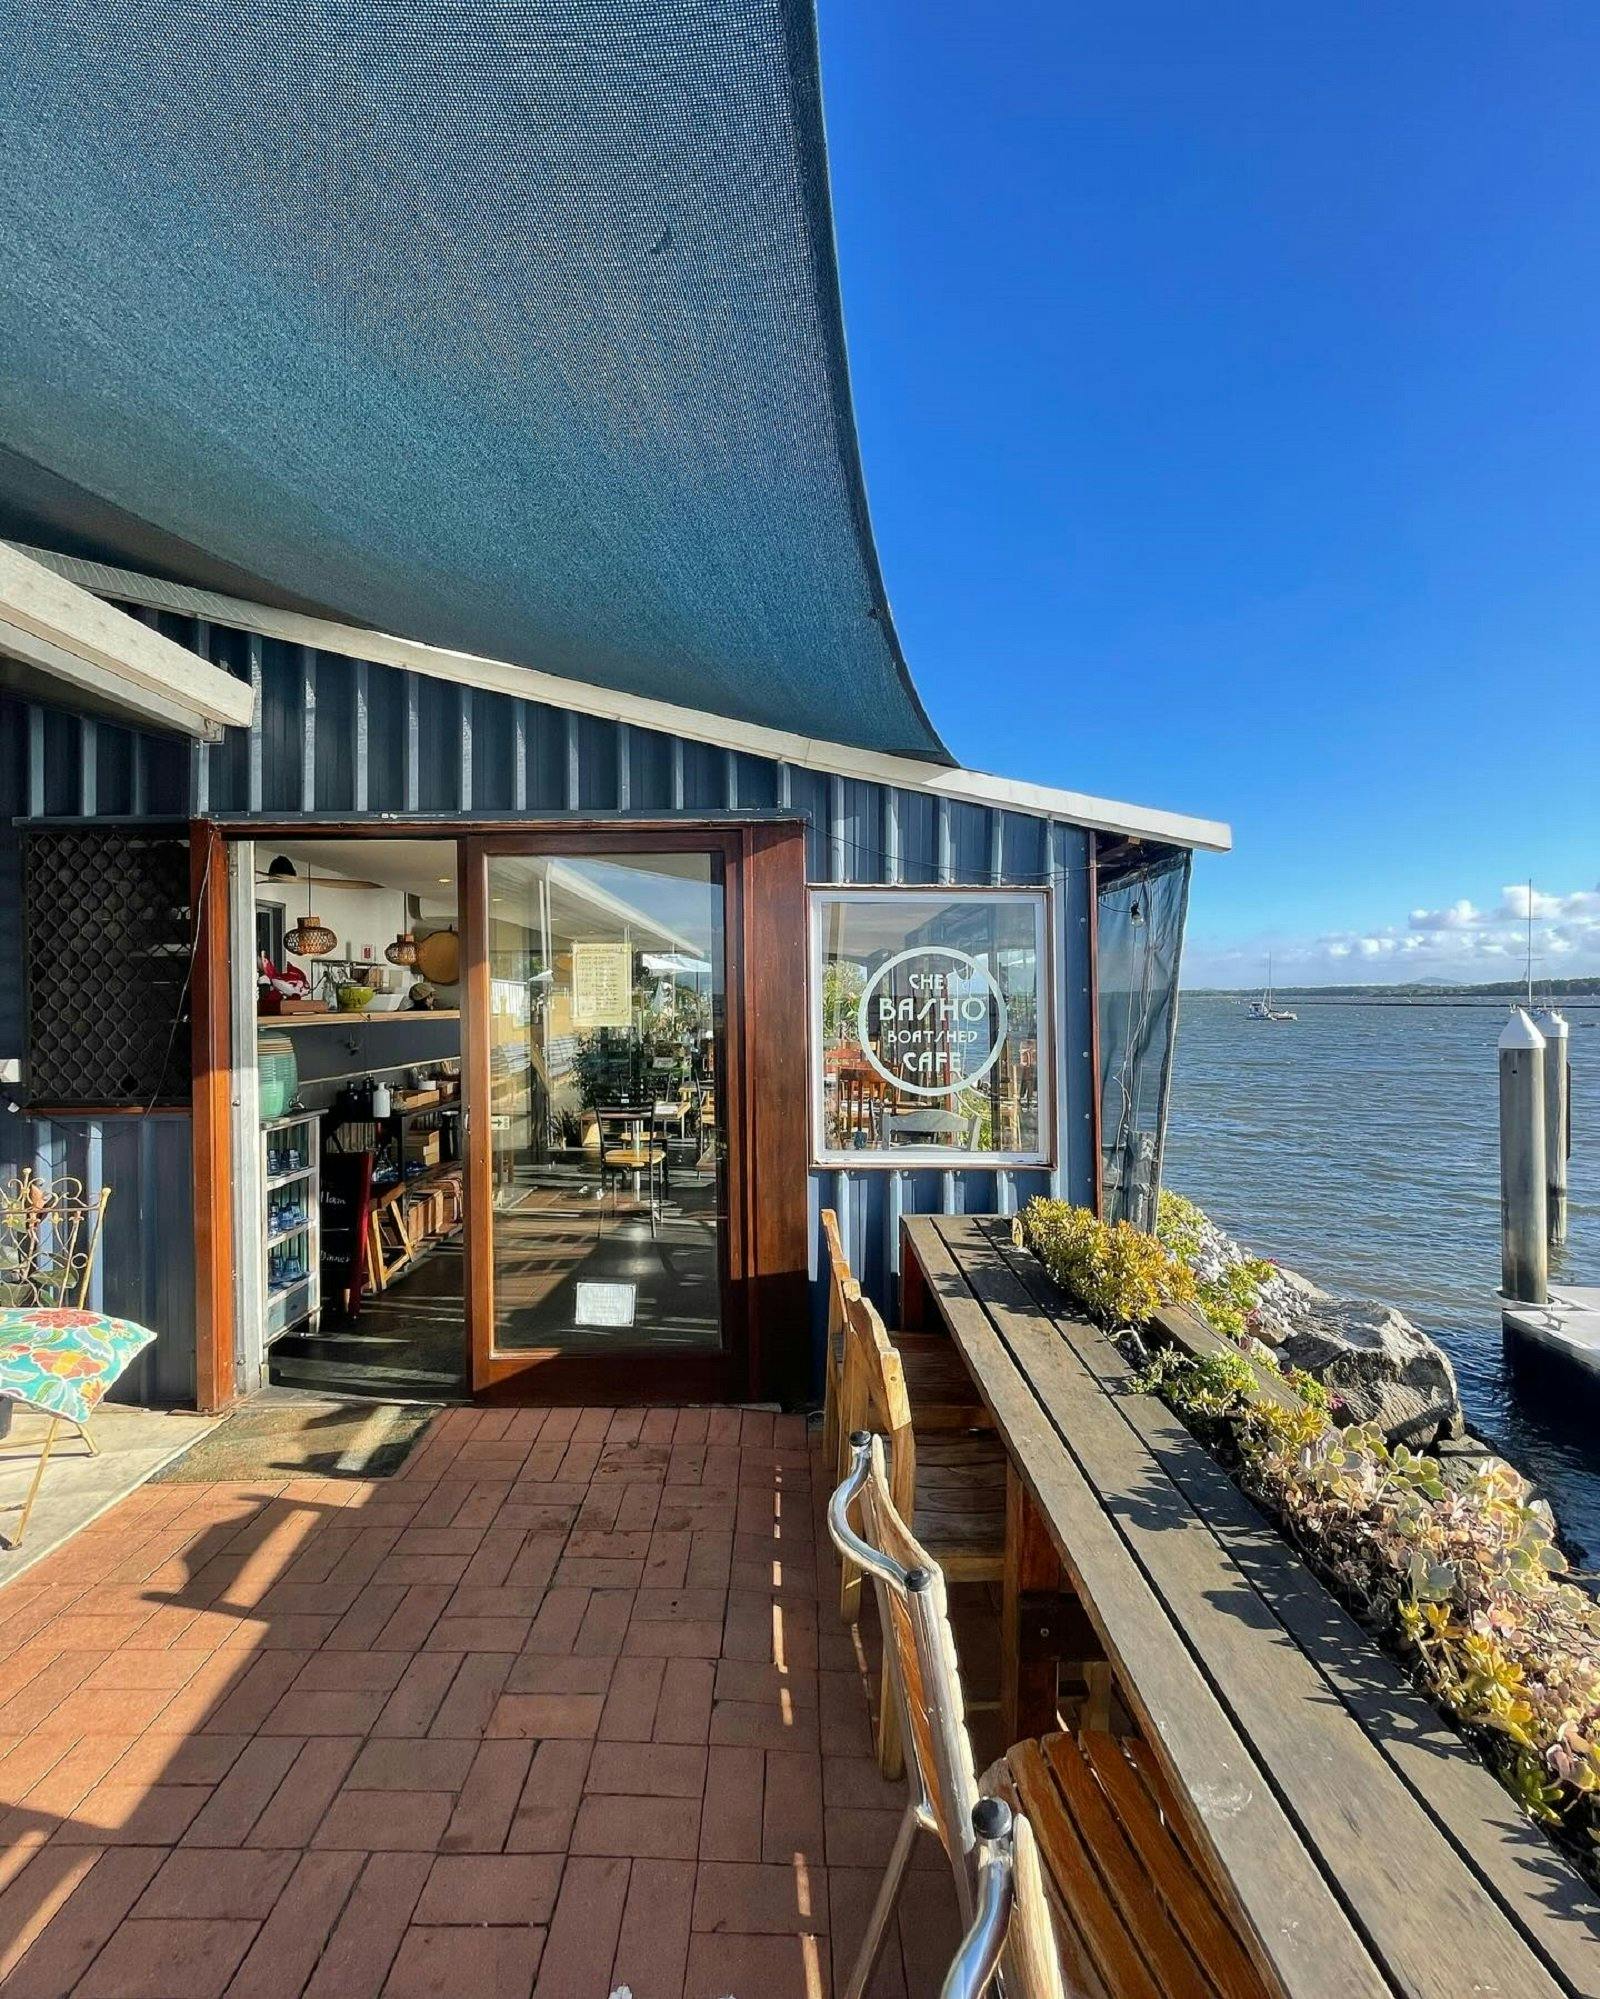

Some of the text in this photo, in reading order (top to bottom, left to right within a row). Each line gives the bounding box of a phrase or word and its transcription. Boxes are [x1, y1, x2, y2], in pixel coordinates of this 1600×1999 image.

[908, 973, 954, 990] CHE
[879, 997, 987, 1021] BASHO
[887, 1030, 978, 1043] BOATSHED
[902, 1051, 962, 1072] CAFE
